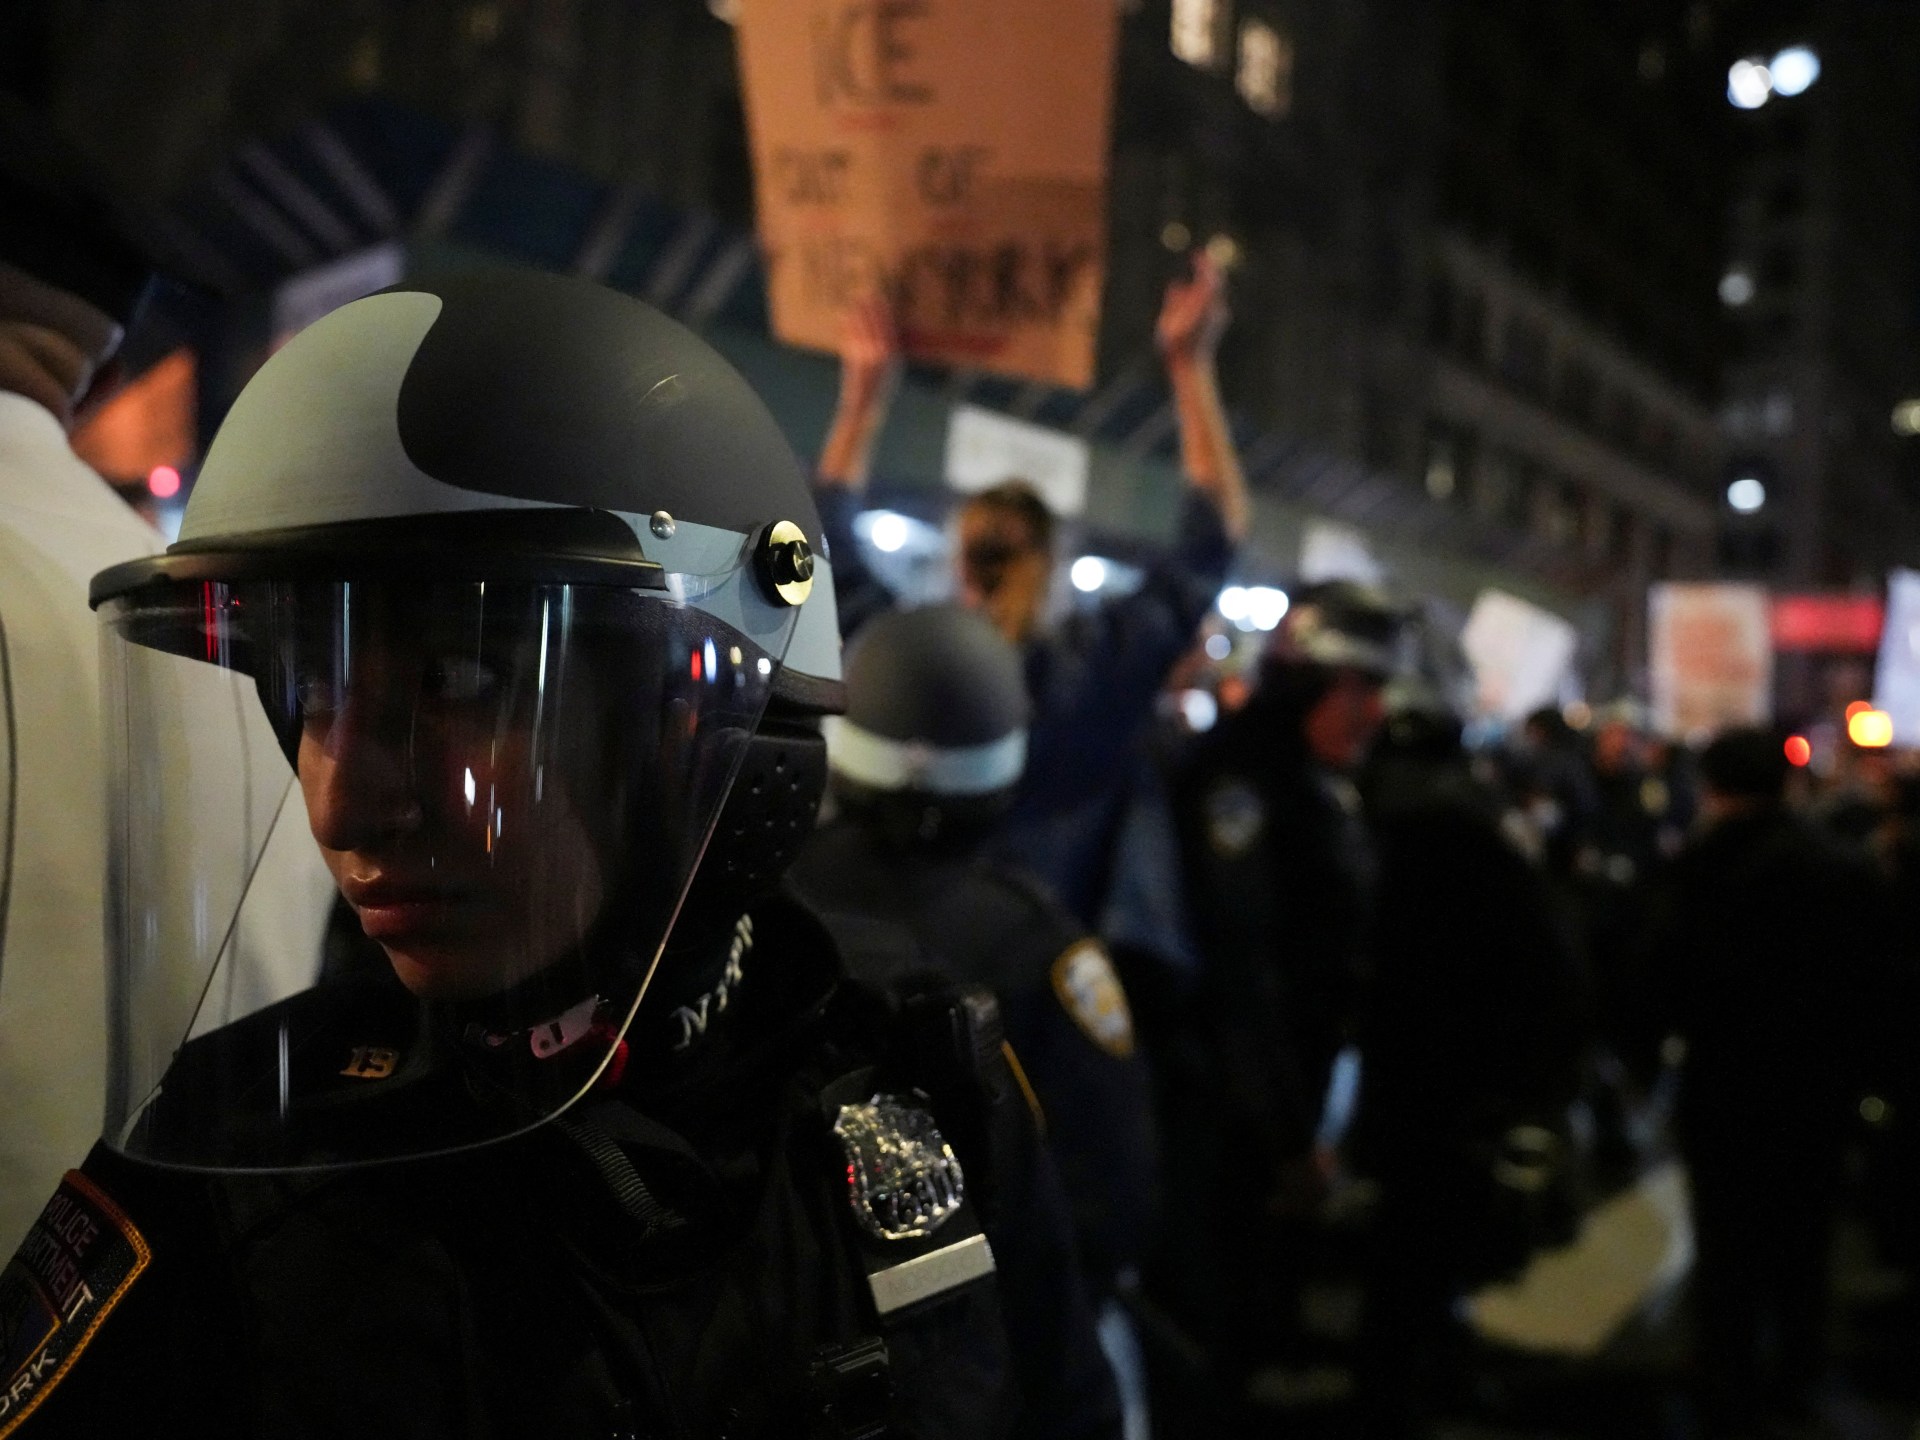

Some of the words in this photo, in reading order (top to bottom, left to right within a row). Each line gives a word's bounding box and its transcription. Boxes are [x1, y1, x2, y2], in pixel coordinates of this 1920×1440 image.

[814, 0, 936, 108] ICE
[916, 145, 992, 207] OF
[669, 911, 754, 1052] NYPD
